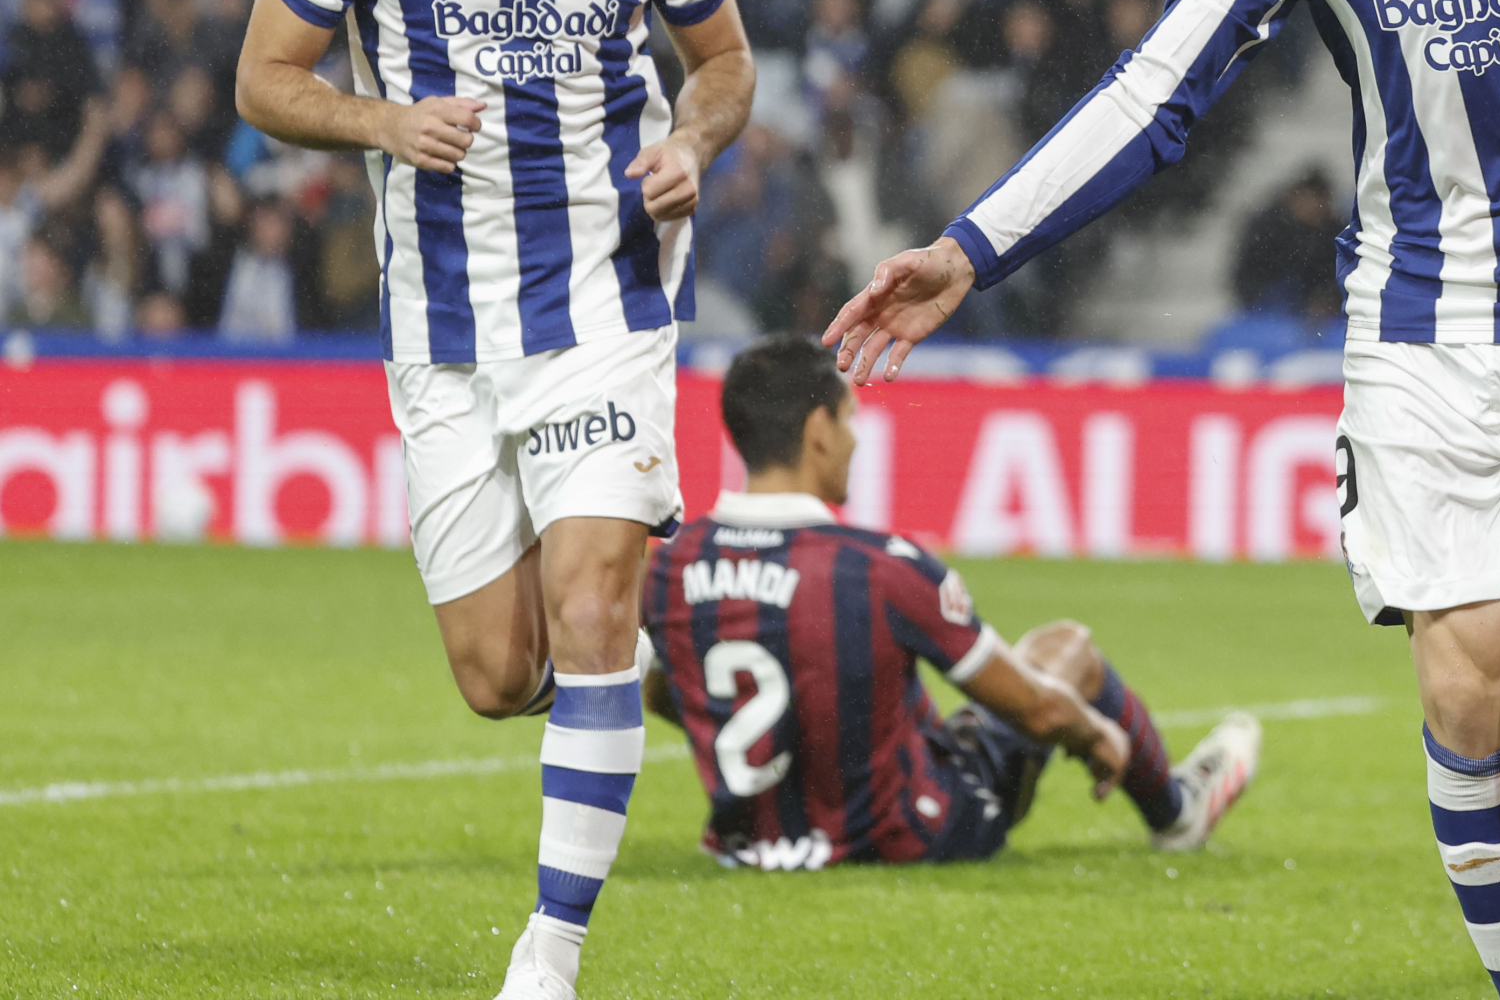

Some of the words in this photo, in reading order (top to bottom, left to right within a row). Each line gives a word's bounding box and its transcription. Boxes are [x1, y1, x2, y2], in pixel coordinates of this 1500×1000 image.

[474, 41, 583, 85] Capital
[682, 558, 800, 609] MANDI
[704, 641, 792, 797] 2
